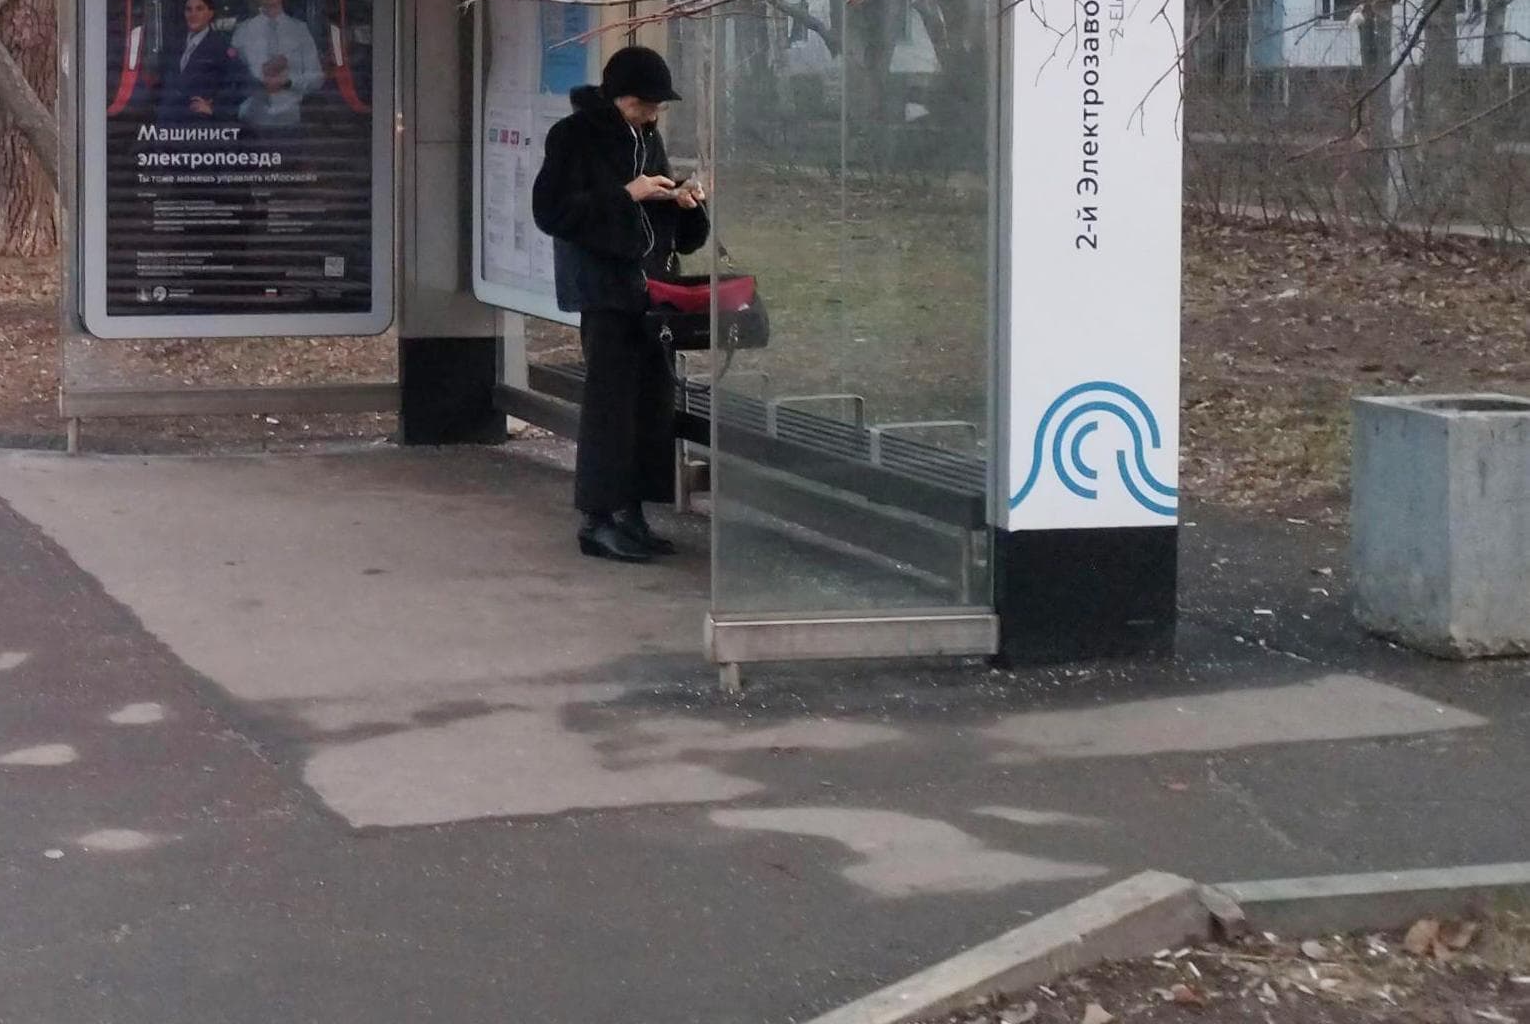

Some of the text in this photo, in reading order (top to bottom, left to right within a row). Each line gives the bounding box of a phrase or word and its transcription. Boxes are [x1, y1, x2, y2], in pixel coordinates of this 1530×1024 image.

[137, 124, 240, 141] Машинист
[137, 152, 282, 169] электропоезда
[177, 175, 215, 183] можешь
[217, 175, 262, 185] управлять
[1075, 207, 1099, 249] 2-й
